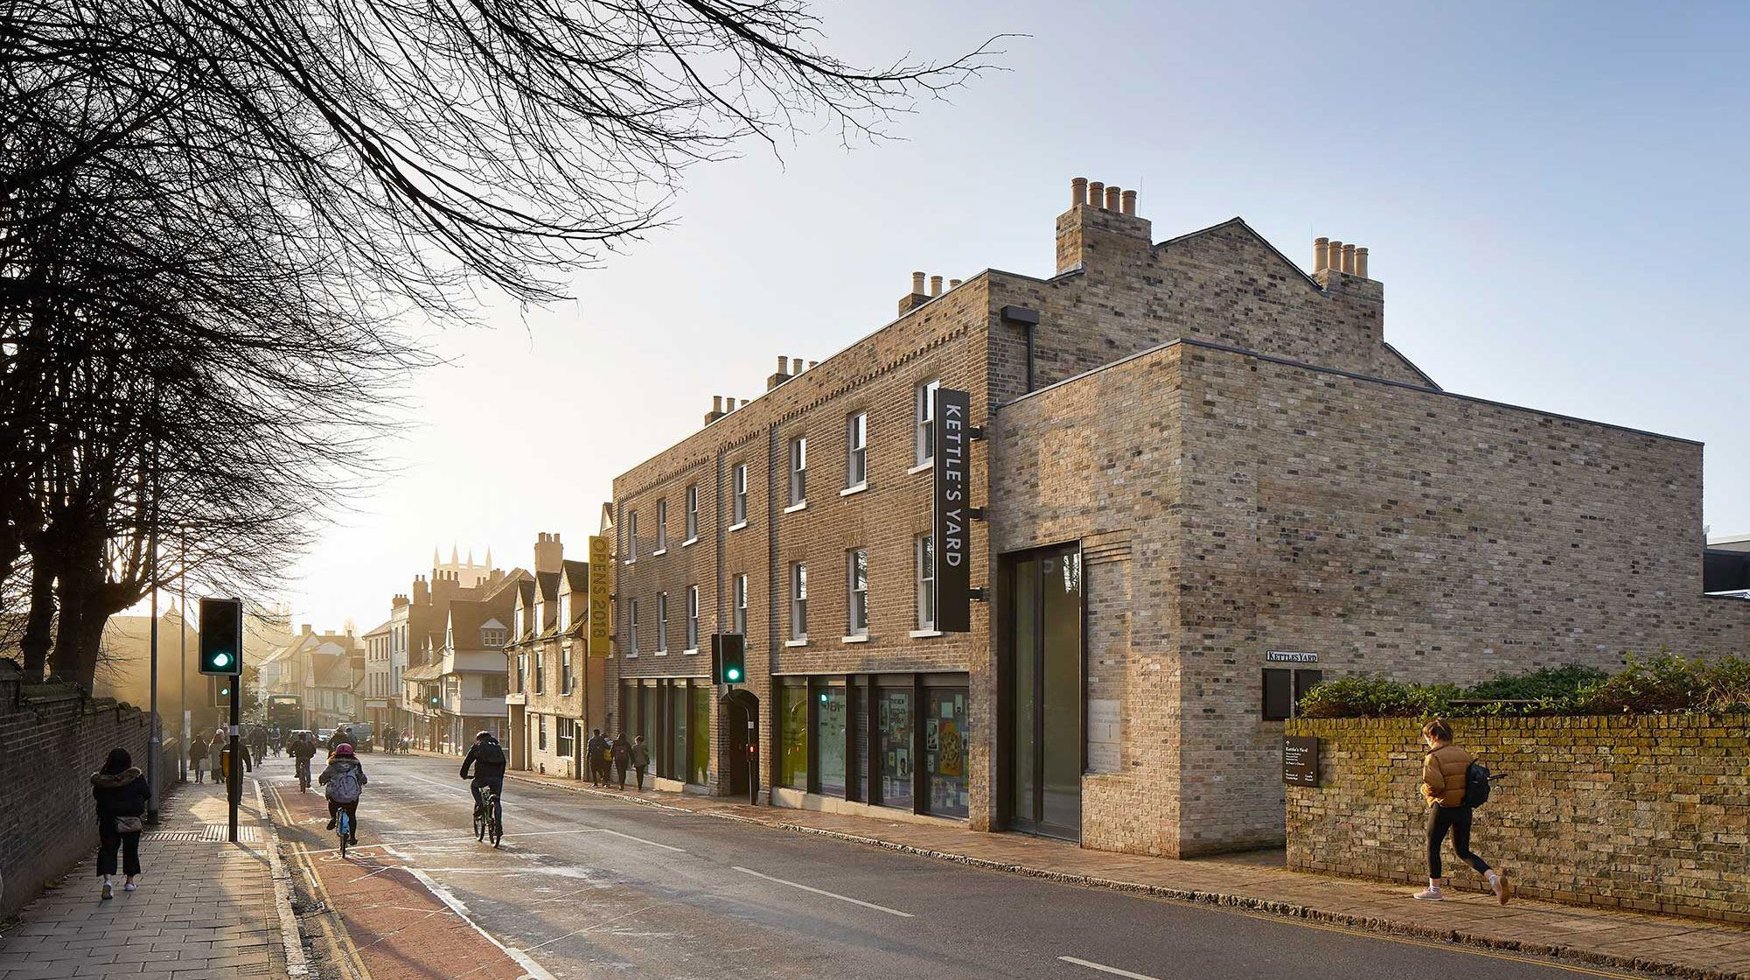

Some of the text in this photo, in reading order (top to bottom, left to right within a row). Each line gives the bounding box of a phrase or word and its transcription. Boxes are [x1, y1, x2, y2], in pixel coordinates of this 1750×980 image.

[946, 404, 962, 567] KETTLE'S YARD
[592, 538, 607, 639] OPENS 2018
